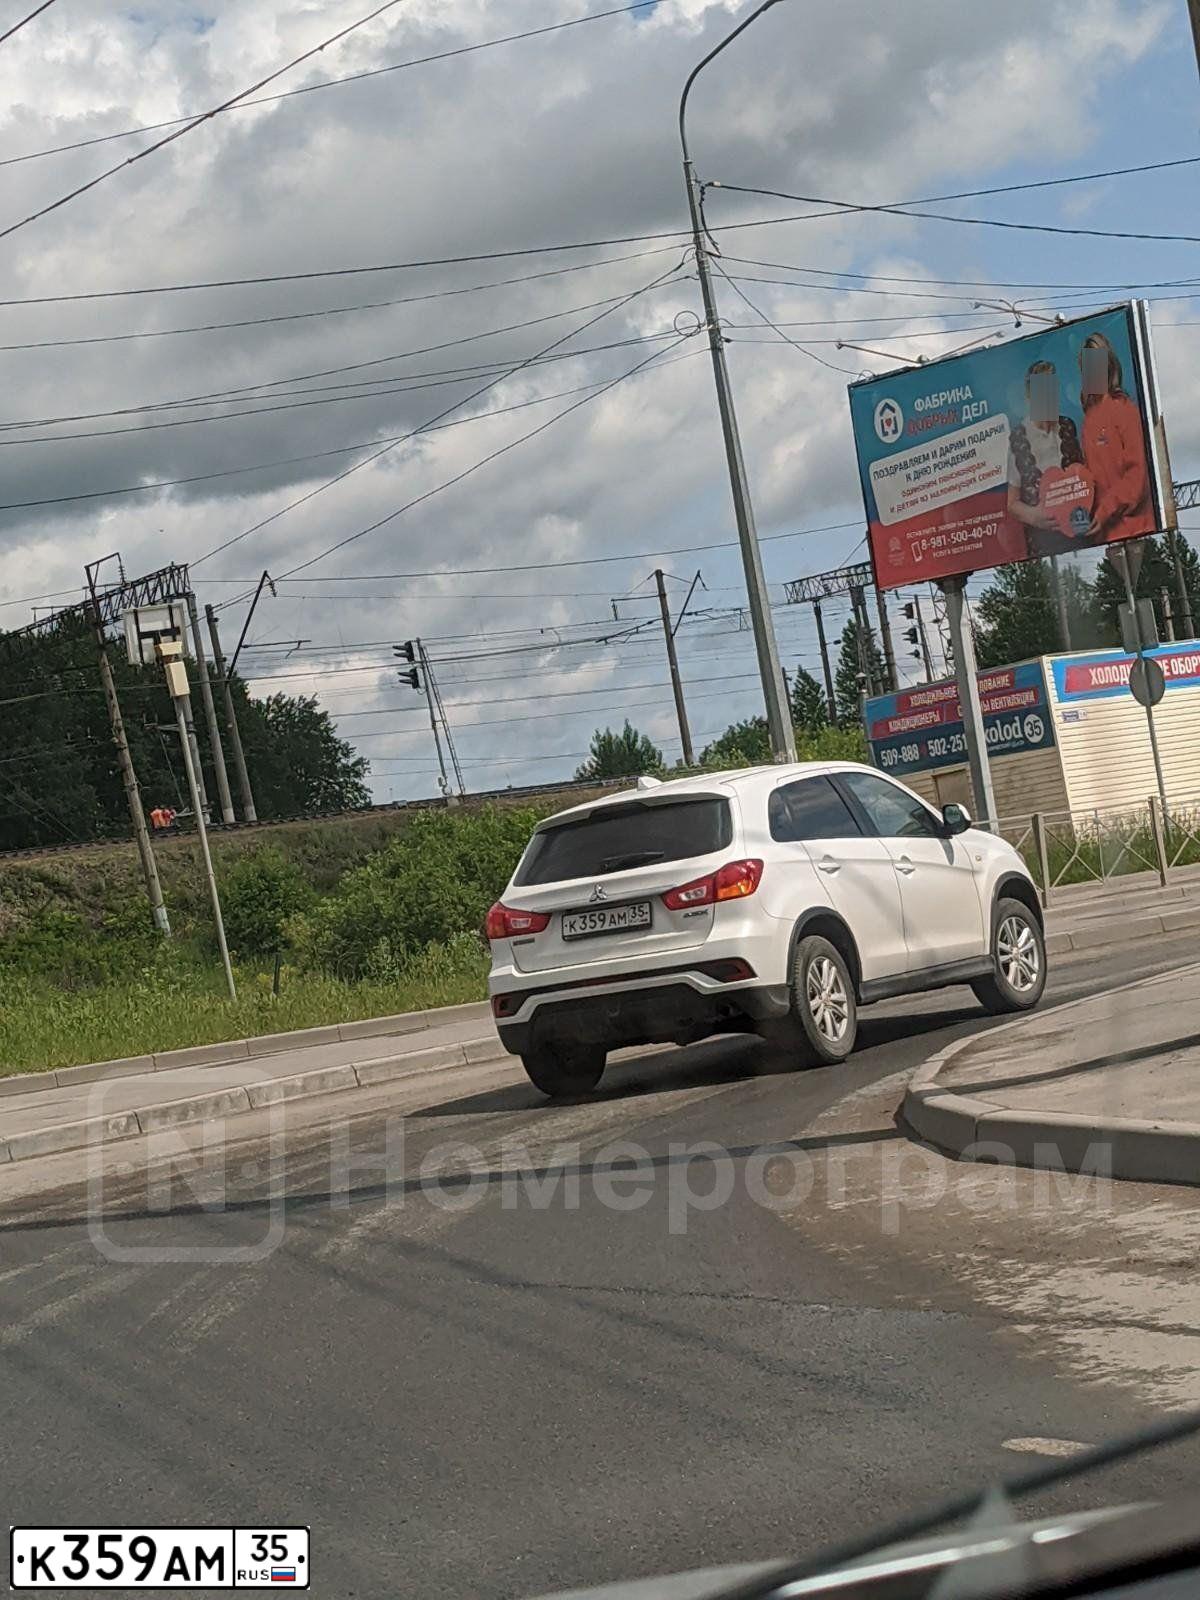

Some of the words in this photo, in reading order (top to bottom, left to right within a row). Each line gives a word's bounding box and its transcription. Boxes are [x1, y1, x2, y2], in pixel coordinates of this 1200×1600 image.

[914, 385, 973, 412] ФАБРИКА
[961, 400, 988, 423] ДЕЛ
[873, 452, 931, 479] ПОЗДРАВЛЯЕМ
[931, 451, 938, 460] И
[939, 440, 966, 458] ДАРИМ
[967, 423, 1006, 445] ПОДАРКИ
[905, 473, 912, 482] К
[913, 466, 931, 481] ДНЮ
[933, 449, 977, 473] РОЖДЕНИЯ
[1026, 720, 1042, 738] 35
[880, 743, 919, 767] 509-888
[927, 733, 968, 757] 502-251
[630, 905, 645, 919] 35
